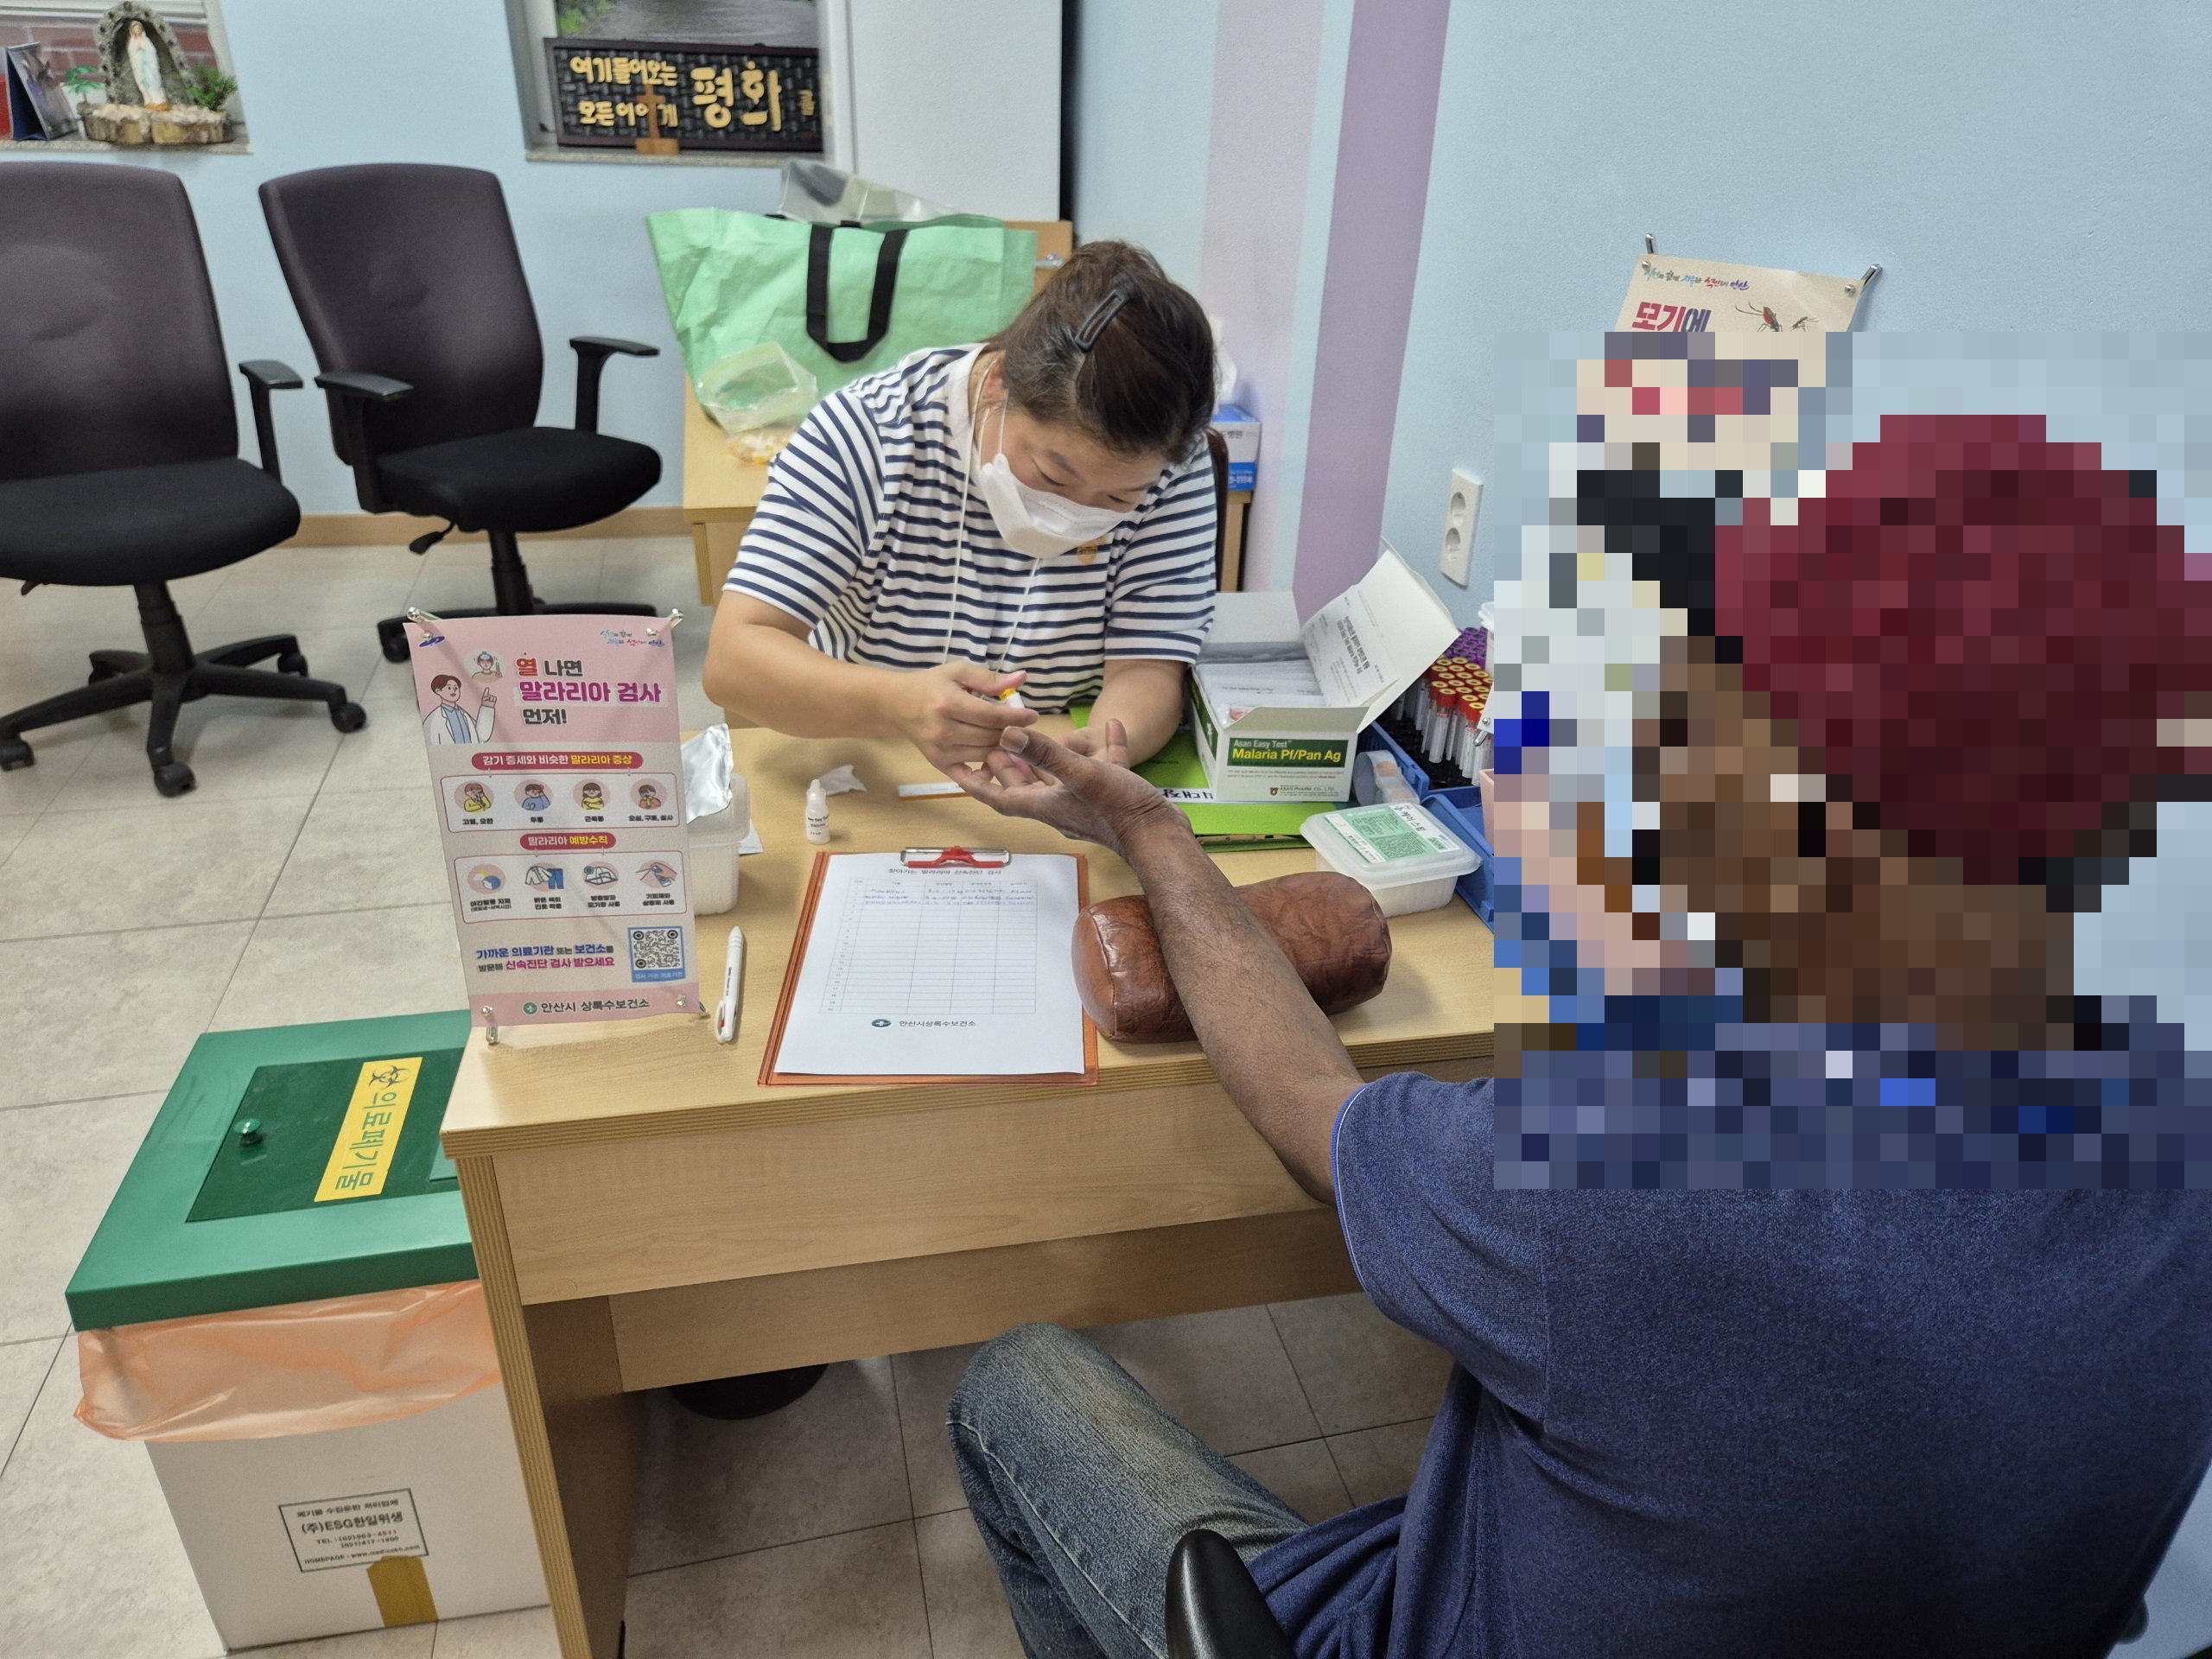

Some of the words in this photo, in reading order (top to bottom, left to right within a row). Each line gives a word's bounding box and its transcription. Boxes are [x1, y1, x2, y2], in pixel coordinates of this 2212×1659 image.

[578, 100, 678, 127] 모든이게
[1632, 301, 1712, 332] 모기에
[516, 658, 538, 677] 열
[544, 659, 583, 677] 나면
[519, 681, 612, 702] 말라리아
[617, 682, 662, 702] 검사
[523, 709, 567, 725] 먼저!
[1253, 741, 1270, 749] Easy
[482, 755, 504, 766] 감기
[505, 754, 537, 766] 증세와
[538, 754, 569, 765] 비슷한
[570, 754, 611, 765] 말라리아
[613, 754, 632, 765] 증상
[1232, 748, 1278, 760] Malaria
[1281, 749, 1321, 760] Pf/Pan
[1324, 750, 1342, 763] Ag
[528, 836, 568, 847] 말라리아
[569, 835, 608, 846] 예방수칙
[477, 948, 509, 960] 가까운
[512, 945, 554, 957] 의료기관
[575, 944, 614, 955] 보건소를
[478, 963, 504, 972] 방문해
[505, 958, 548, 970] 신속진단
[550, 958, 571, 969] 검사
[573, 957, 615, 968] 받으세요
[541, 1002, 576, 1013] 안산시
[581, 999, 650, 1012] 상록수보건소
[335, 1091, 397, 1191] 의료폐기물
